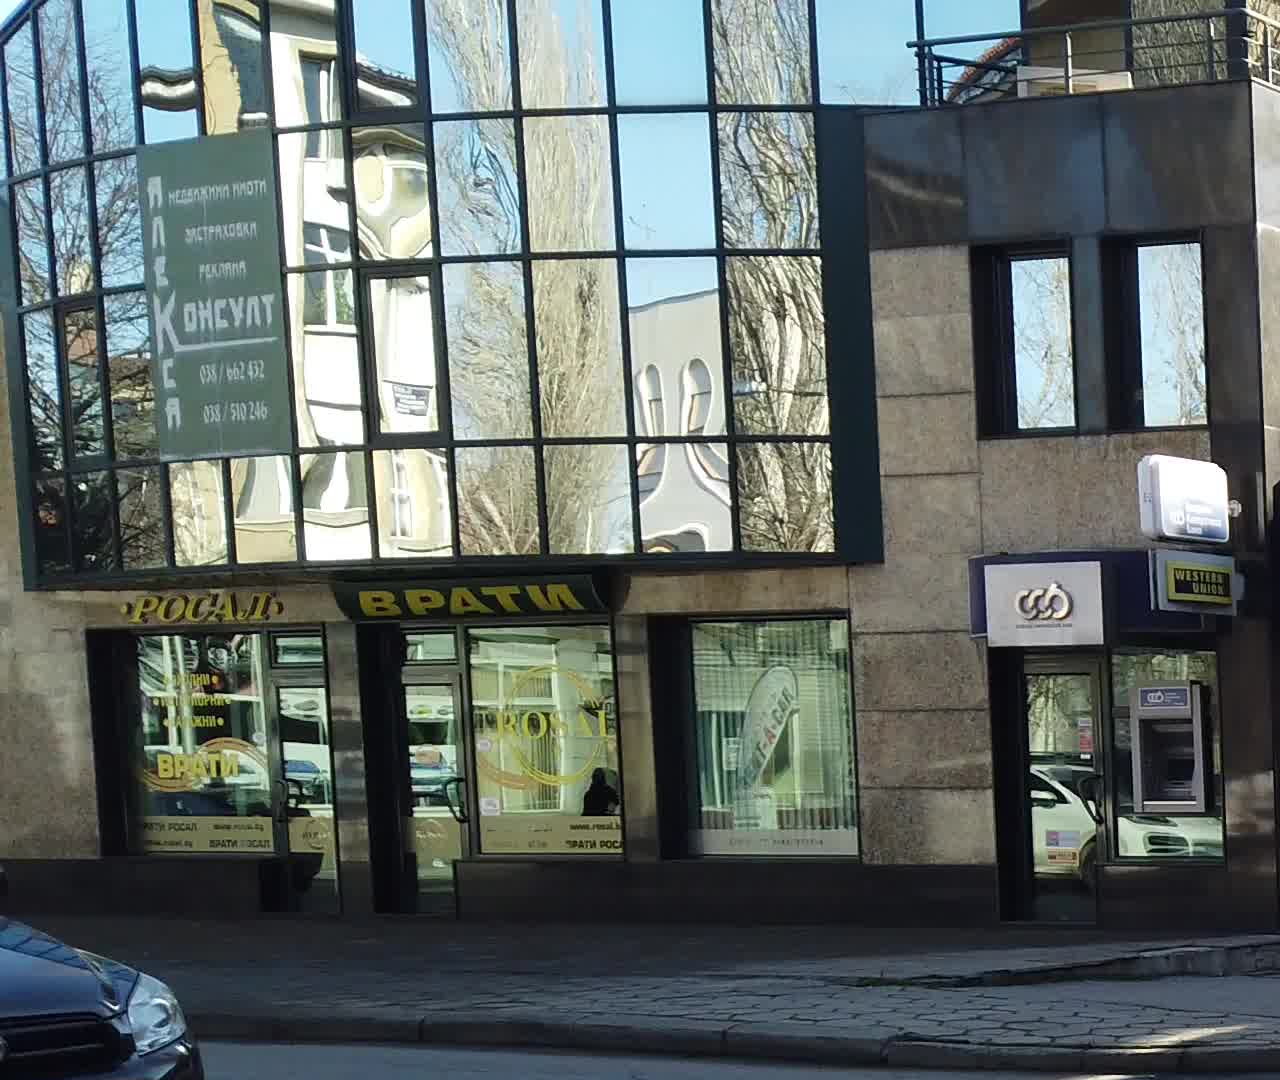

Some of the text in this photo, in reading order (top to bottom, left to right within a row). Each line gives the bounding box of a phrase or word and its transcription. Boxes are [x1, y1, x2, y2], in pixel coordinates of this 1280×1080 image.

[1174, 568, 1223, 584] WESTERN
[1192, 583, 1225, 595] UNION
[128, 589, 272, 624] РОСАЛ
[358, 583, 585, 617] ВРАТИ
[157, 752, 240, 778] ВРАТИ
